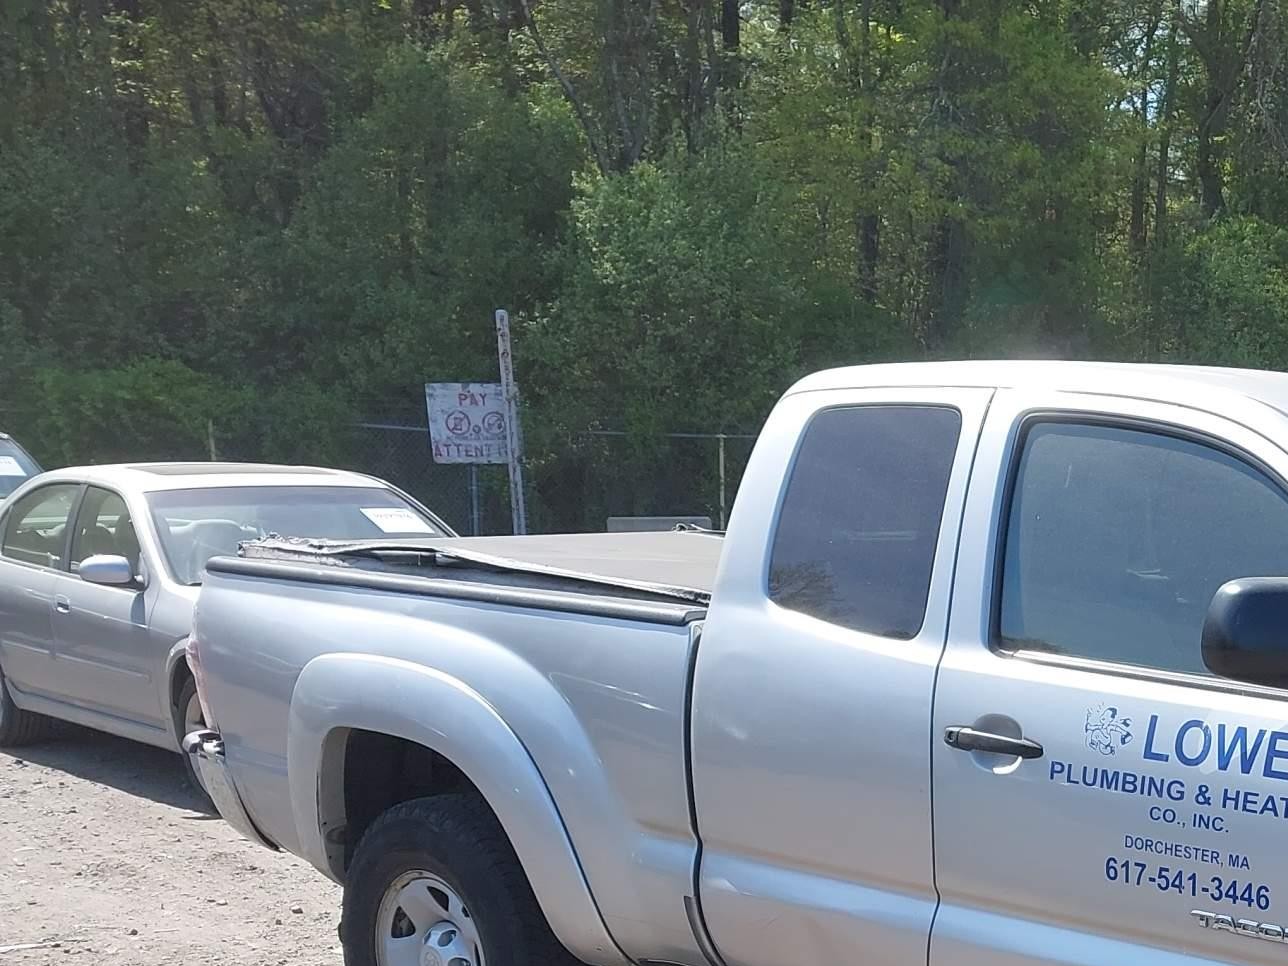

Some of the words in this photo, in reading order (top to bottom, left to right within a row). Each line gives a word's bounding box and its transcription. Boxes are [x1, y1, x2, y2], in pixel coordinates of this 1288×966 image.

[458, 393, 487, 406] PAY
[1050, 761, 1185, 801] PLUMBING
[1194, 784, 1212, 806] &
[1149, 806, 1186, 828] CO.,
[1192, 813, 1230, 833] INC.
[1124, 835, 1224, 867] DORCHESTER,
[1228, 854, 1250, 870] MA
[1105, 857, 1270, 910] 617-541-3446
